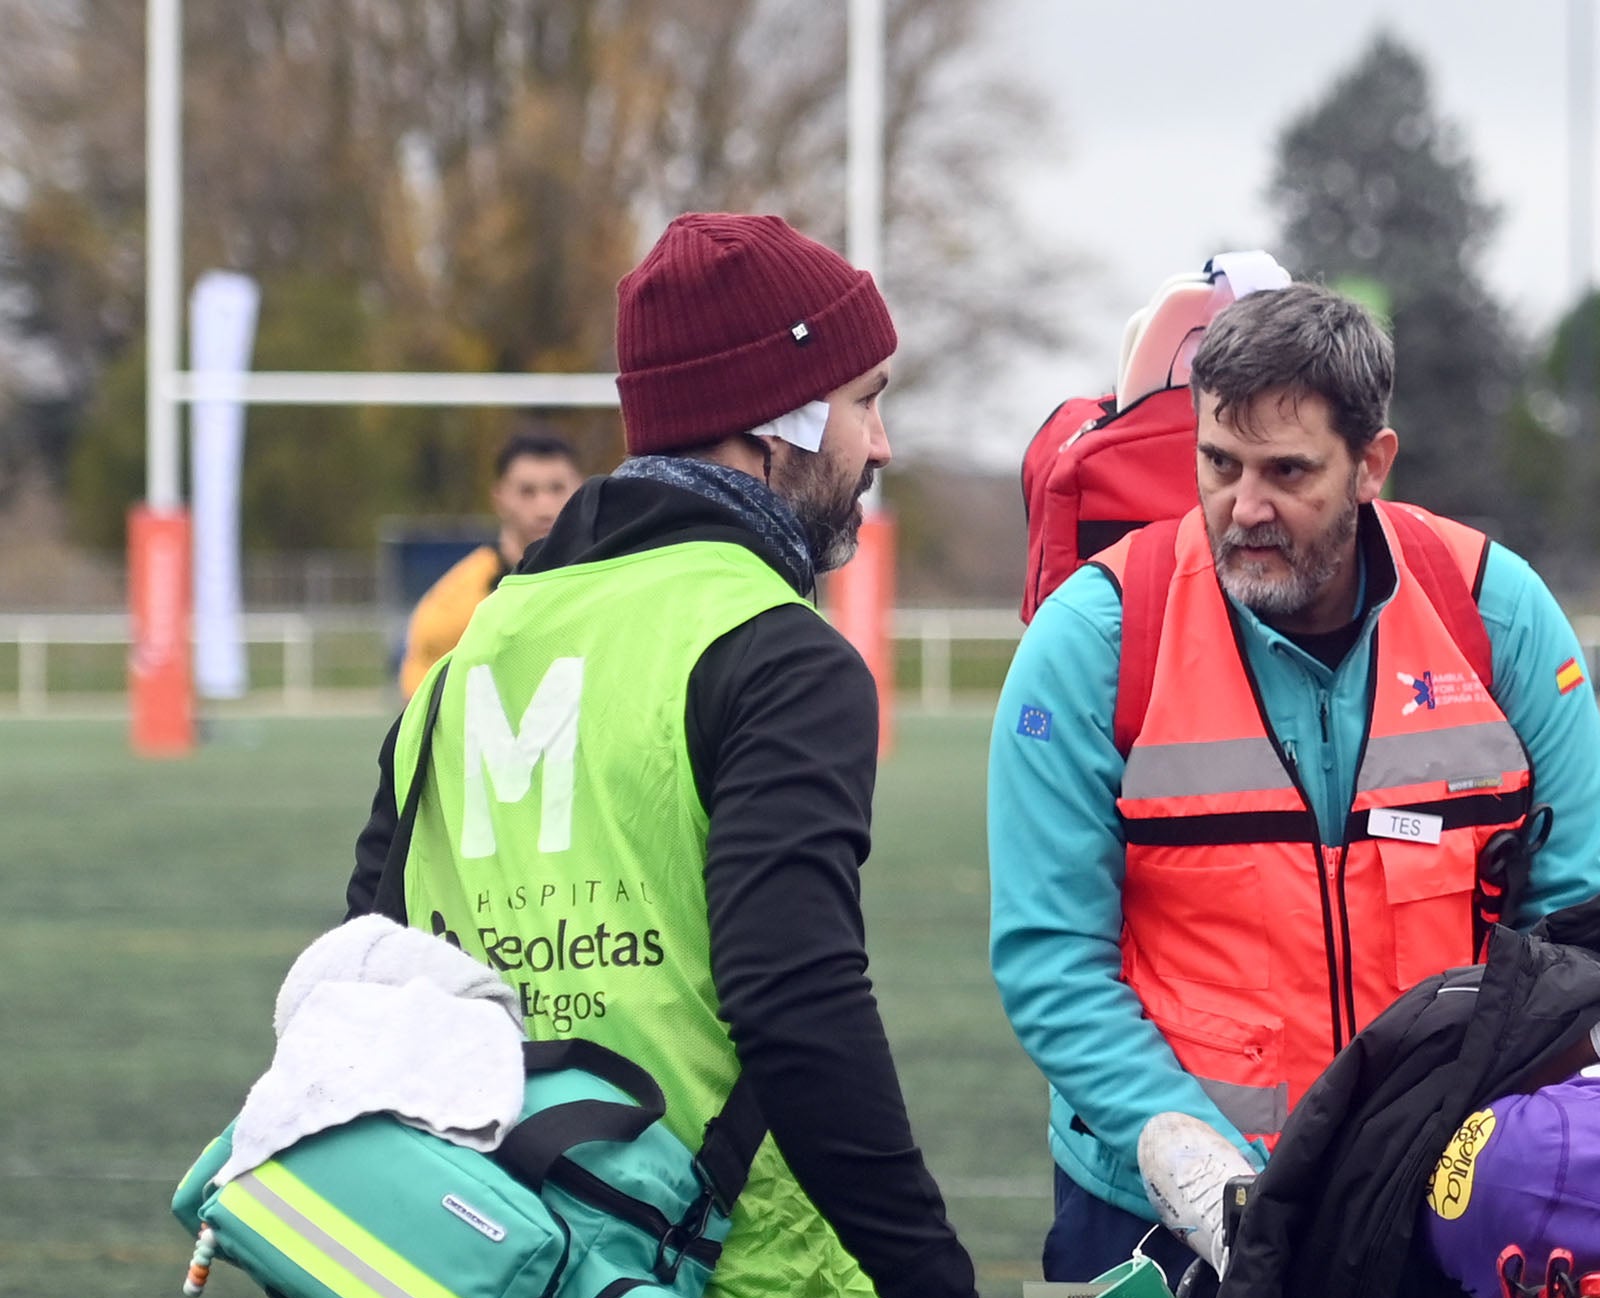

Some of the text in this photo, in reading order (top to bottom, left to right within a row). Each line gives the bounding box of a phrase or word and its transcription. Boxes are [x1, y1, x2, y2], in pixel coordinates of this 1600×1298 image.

[460, 656, 587, 859] M
[1390, 815, 1422, 836] TES
[477, 879, 653, 913] HSPITAL
